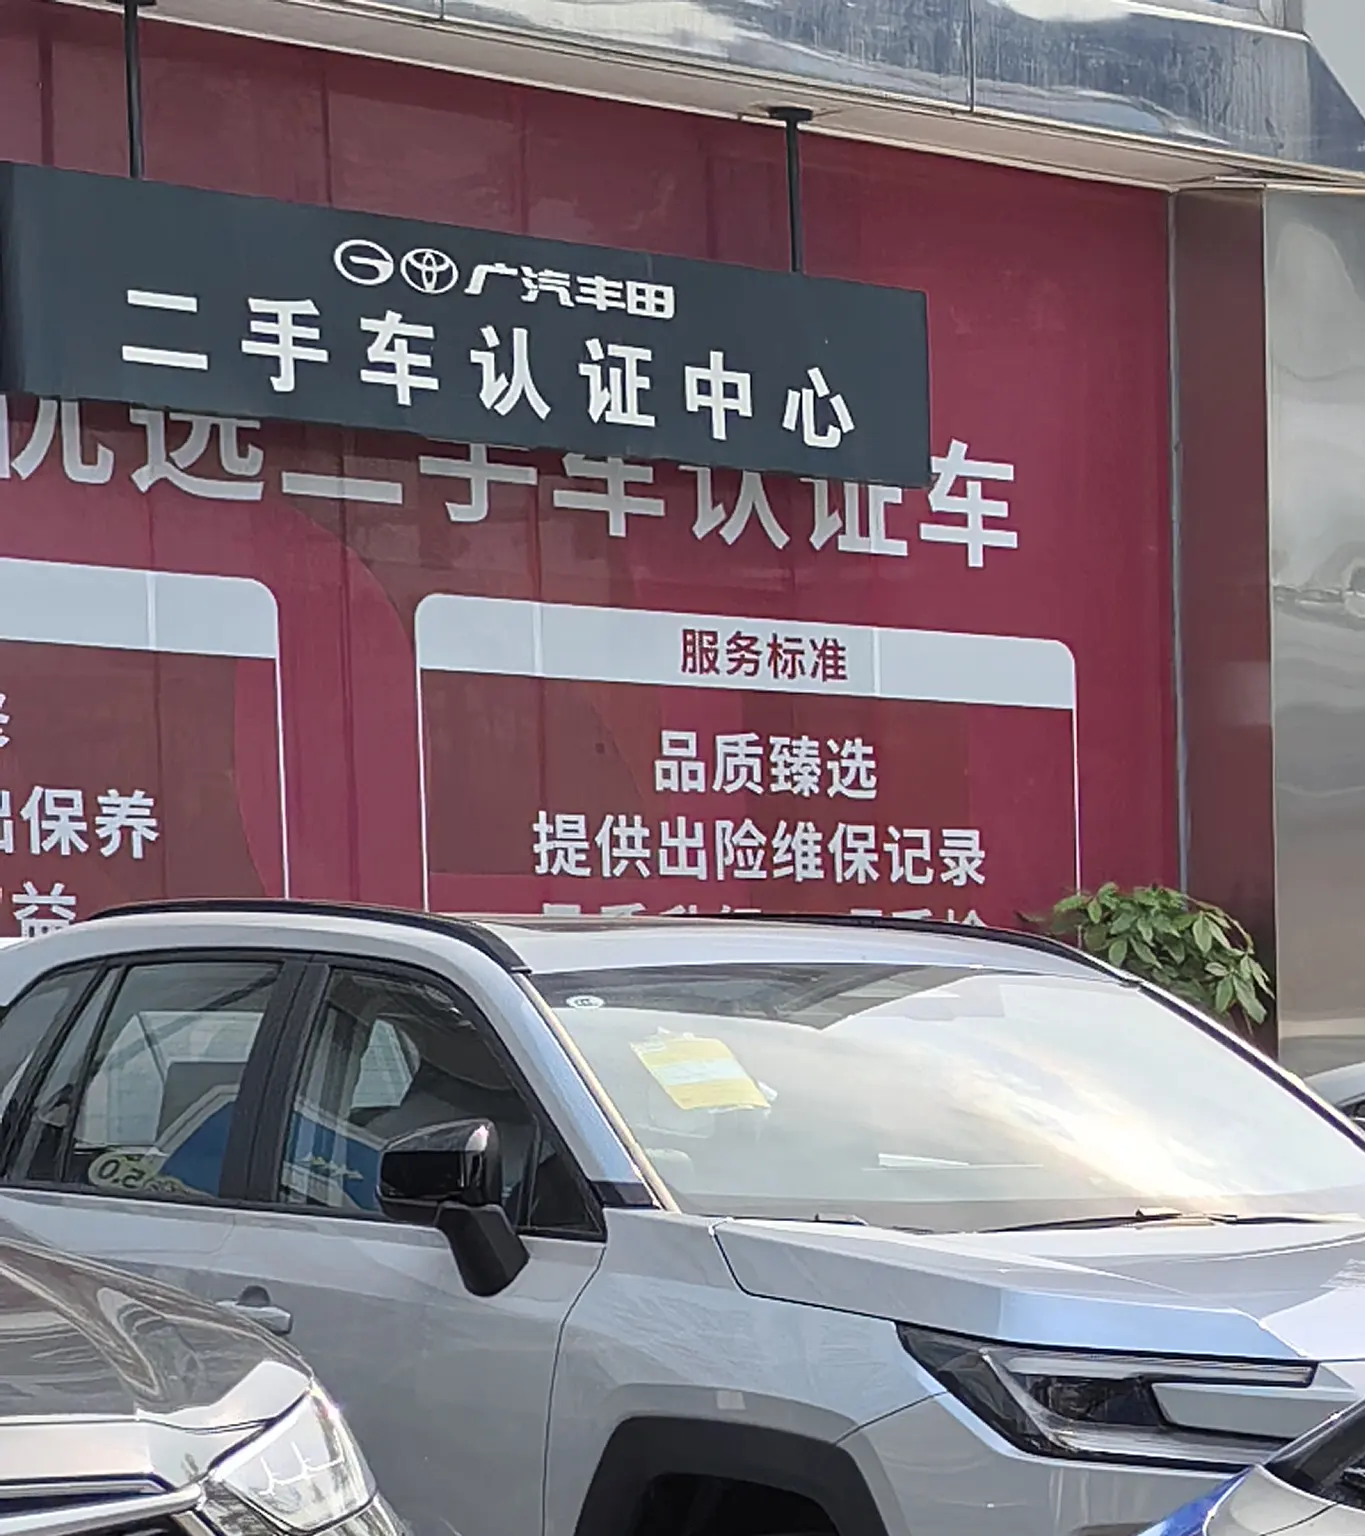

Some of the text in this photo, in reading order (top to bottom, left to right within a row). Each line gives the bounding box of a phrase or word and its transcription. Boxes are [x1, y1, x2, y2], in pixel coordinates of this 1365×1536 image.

[464, 262, 676, 320] 广汽丰田
[122, 289, 856, 449] 二手车认证中心
[681, 629, 848, 683] 服务标准
[654, 730, 878, 799] 品质臻选
[533, 811, 987, 886] 提供出险维保记录
